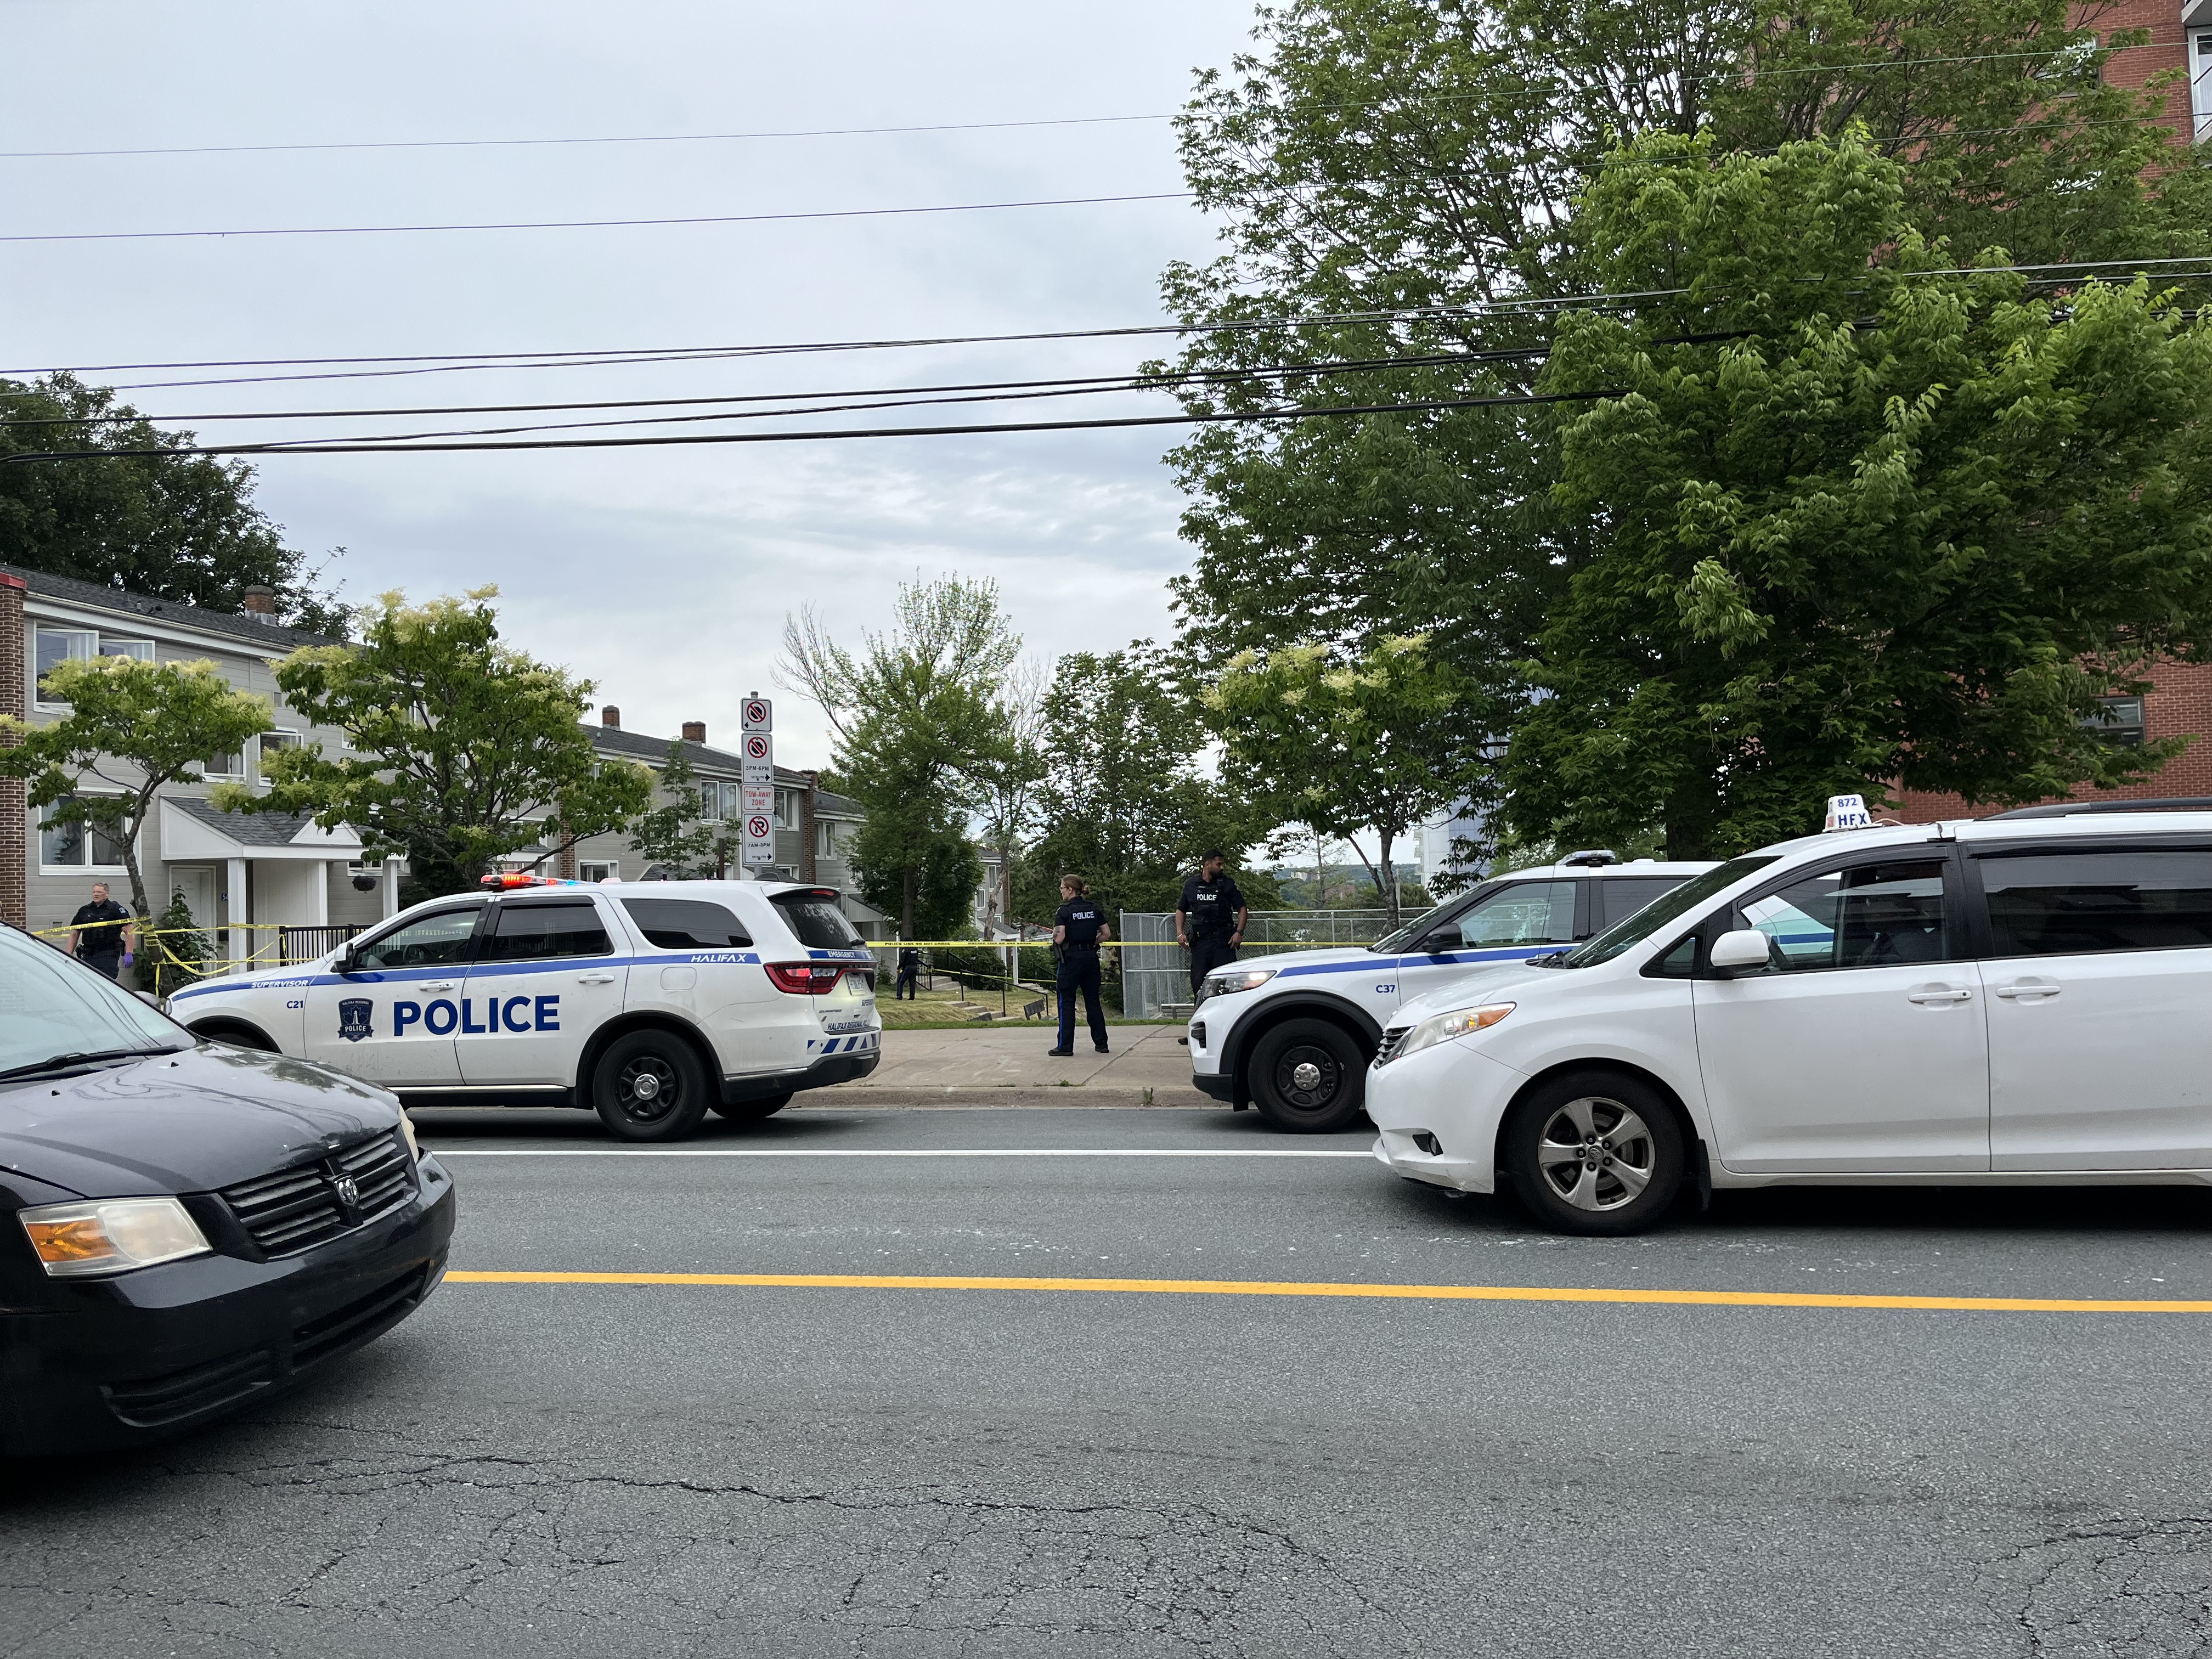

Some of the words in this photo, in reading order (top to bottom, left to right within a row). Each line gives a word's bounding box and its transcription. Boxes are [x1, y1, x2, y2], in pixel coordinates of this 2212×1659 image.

[1837, 797, 1858, 807] 872
[1073, 911, 1094, 920] POLICE
[690, 954, 747, 963] HALIFAX
[251, 980, 308, 989] SUPERVISOR
[1375, 984, 1396, 993] C37
[286, 1000, 303, 1009] C21
[394, 995, 560, 1036] POLICE
[827, 1022, 847, 1030] HALIFAX
